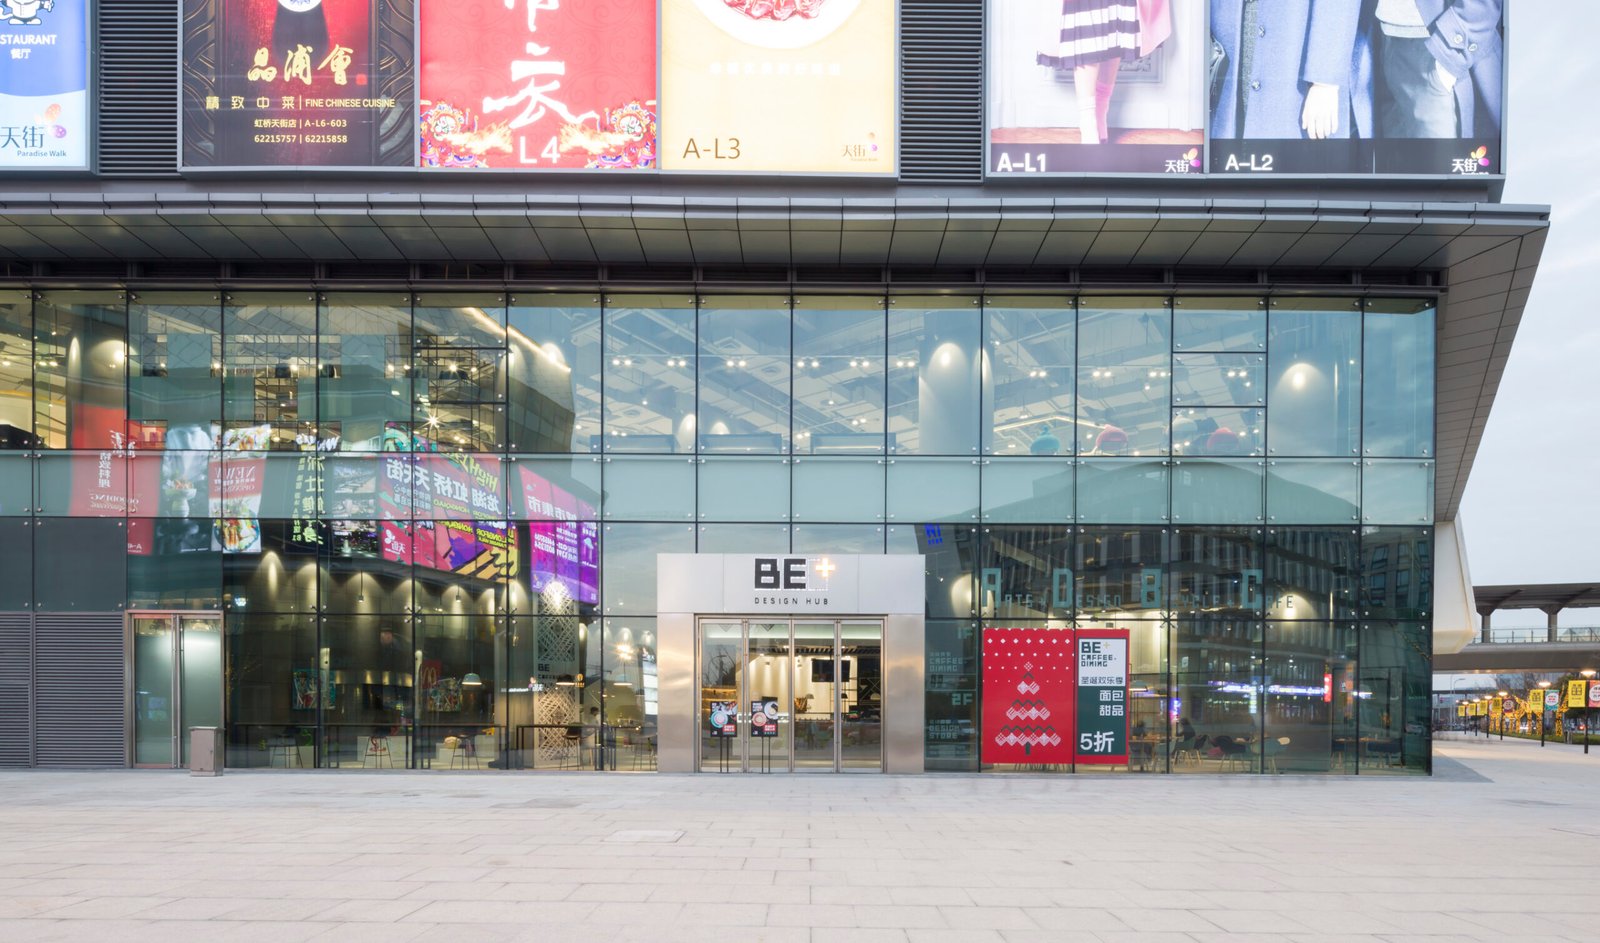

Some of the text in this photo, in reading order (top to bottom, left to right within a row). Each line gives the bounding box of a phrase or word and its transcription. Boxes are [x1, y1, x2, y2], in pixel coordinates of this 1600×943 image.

[305, 98, 324, 108] FINE
[325, 98, 361, 108] CHINESE
[362, 98, 395, 108] CUISINE
[254, 118, 347, 128] 虹桥天街店 A-L6-603
[0, 125, 45, 149] 天街
[254, 134, 347, 143] 62215757 62215858
[17, 149, 67, 157] Paradise Walk
[519, 136, 561, 164] L4
[682, 137, 741, 160] A-L3
[842, 144, 866, 157] 天街
[996, 152, 1047, 172] A-L1
[1164, 159, 1189, 173] 天街
[1225, 154, 1273, 171] A-L2
[1451, 158, 1477, 172] 天街
[754, 597, 829, 605] DESIGN HUB
[951, 693, 973, 705] 2F
[1099, 690, 1124, 701] 面包
[1099, 704, 1124, 716] 甜品
[1080, 731, 1115, 753] 5折
